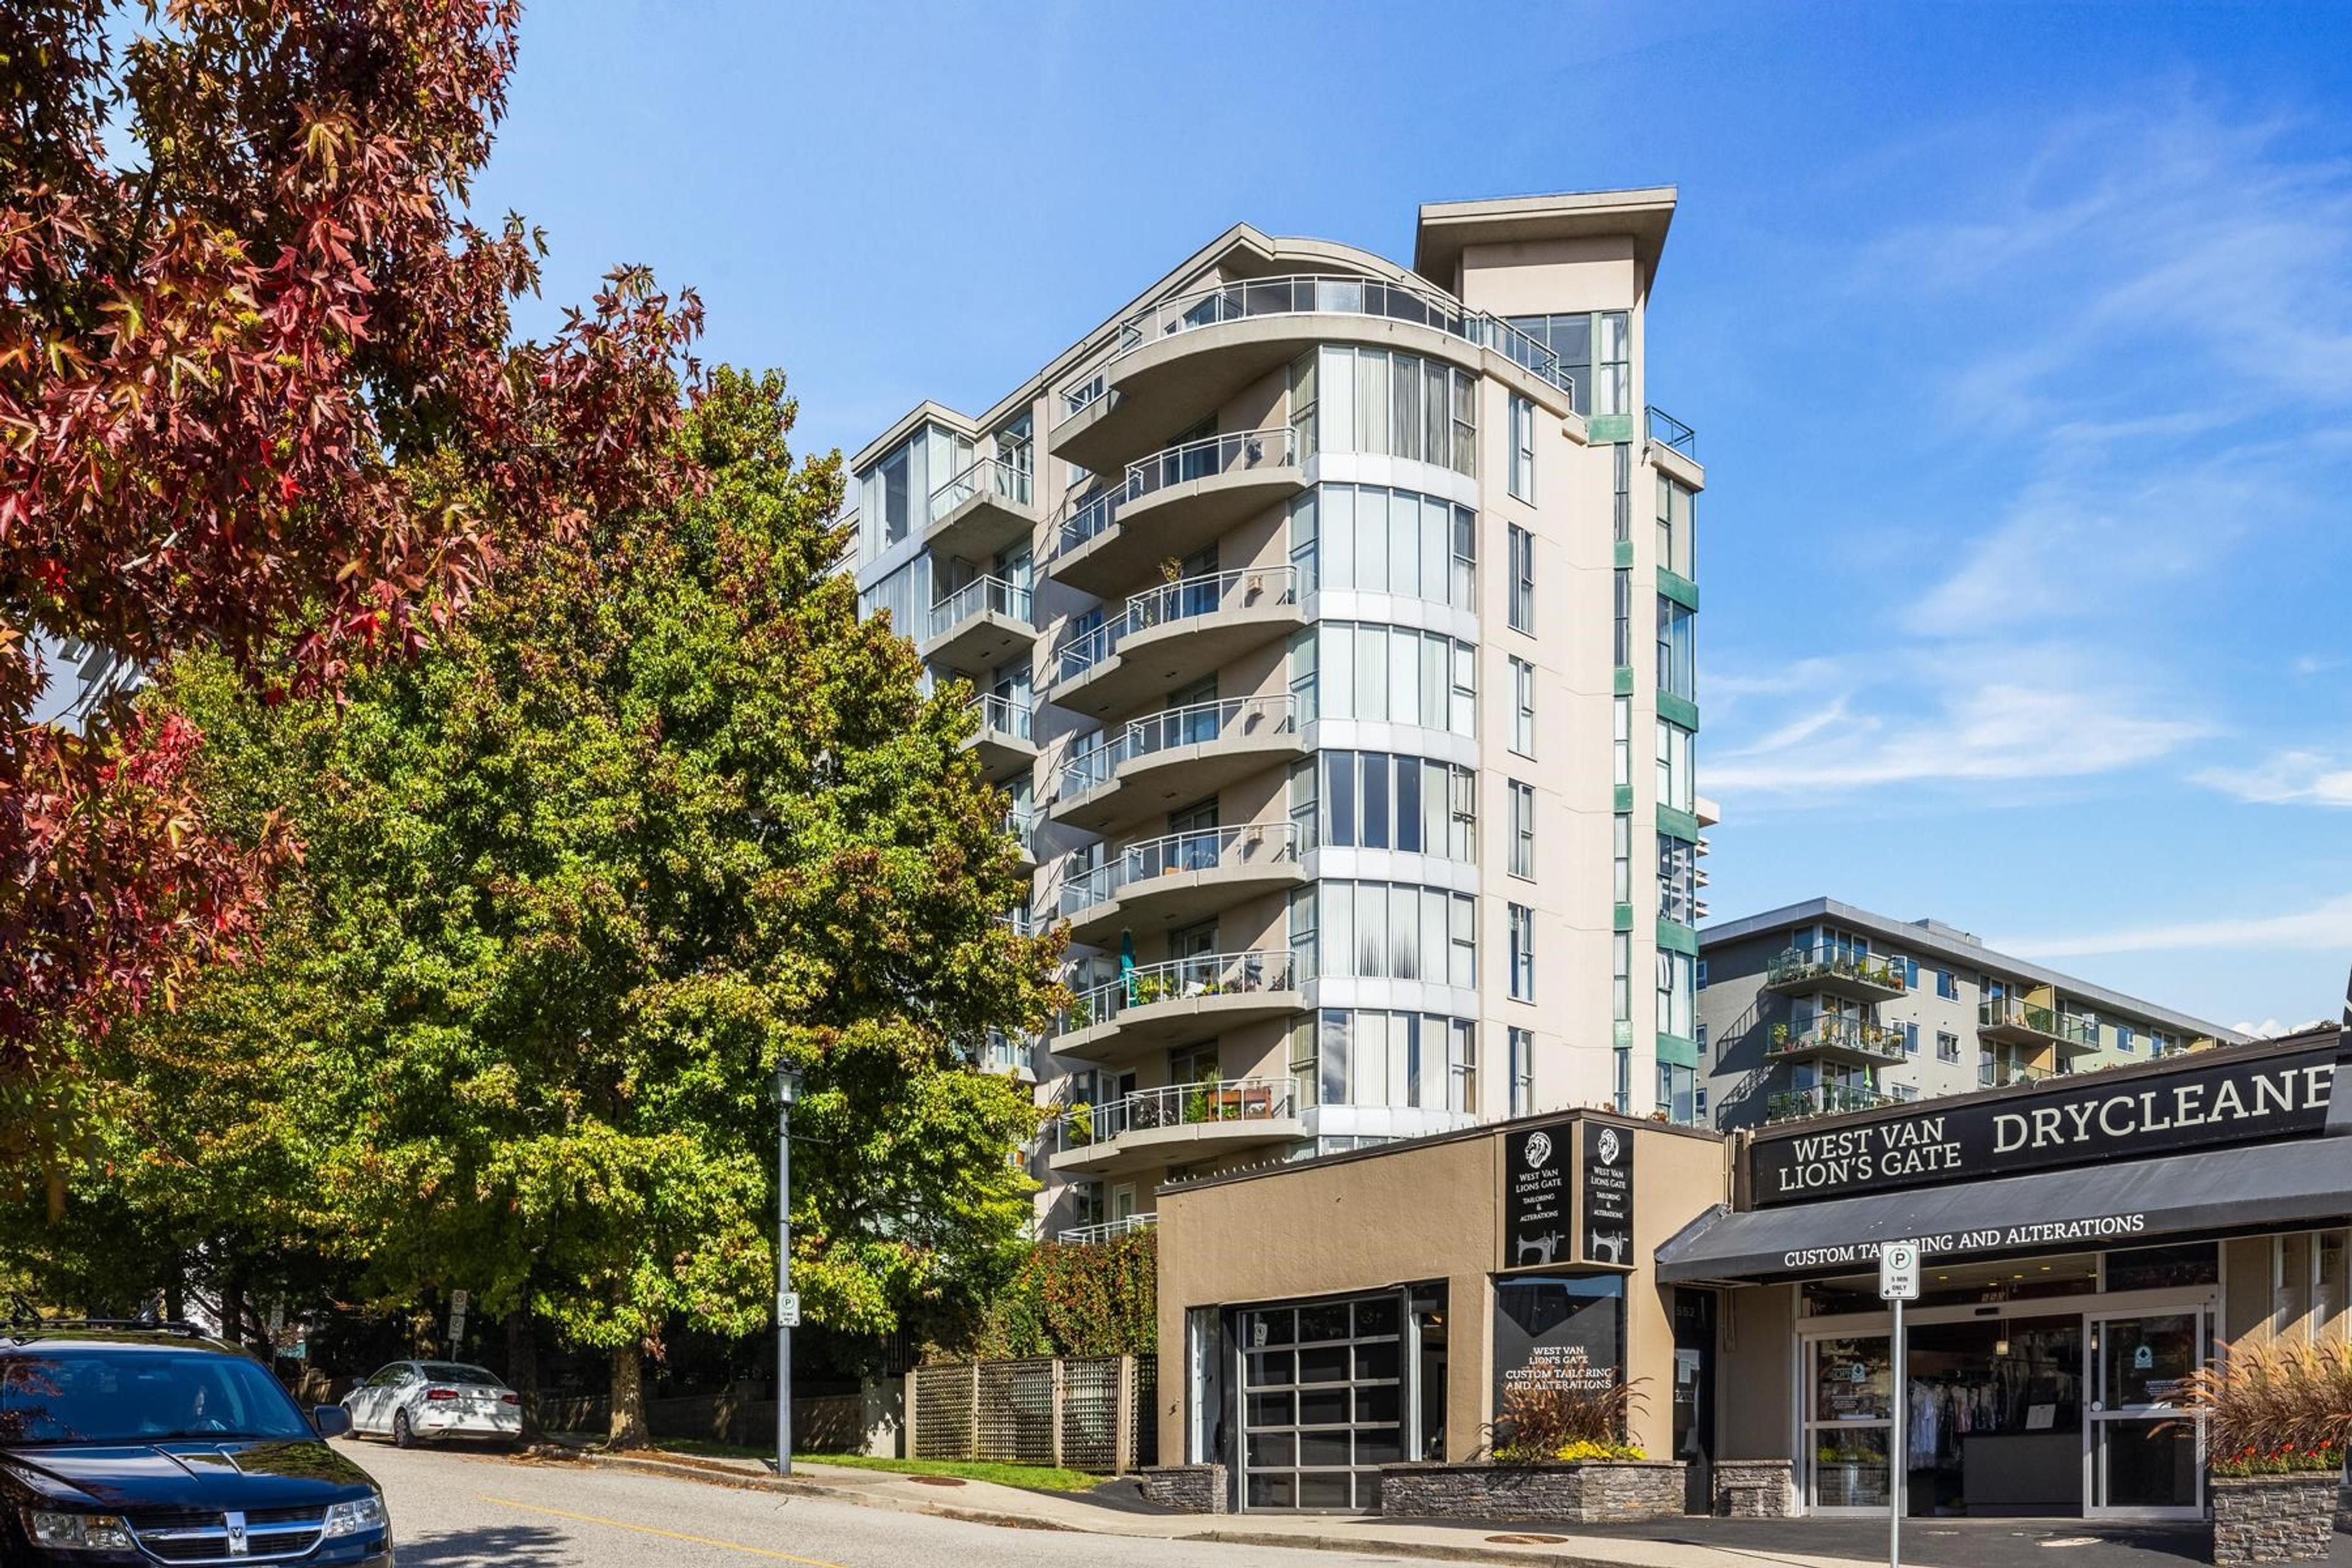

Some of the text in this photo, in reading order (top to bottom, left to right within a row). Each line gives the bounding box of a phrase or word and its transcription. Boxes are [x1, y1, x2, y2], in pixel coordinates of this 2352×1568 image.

[1793, 1117, 1945, 1163] WEST VAN
[1593, 1166, 1624, 1178] WEST VAN
[1779, 1142, 1962, 1191] LION'S GATE
[1520, 1168, 1559, 1182] WEST VAN
[1515, 1178, 1562, 1193] LIONS GATE
[1591, 1175, 1626, 1189] LIONS GATE
[1523, 1193, 1556, 1205] TAILORING
[1596, 1191, 1621, 1201] TAILORING
[1519, 1209, 1559, 1223] ALTERATIONS
[1593, 1209, 1624, 1219] ALTERATIONS
[1785, 1245, 1855, 1267] CUSTOM
[1958, 1230, 2000, 1249] AND
[2006, 1214, 2144, 1244] ALTERATIONS
[1896, 1253, 1905, 1265] P
[1562, 1346, 1584, 1355] VAN
[1529, 1355, 1588, 1365] LION'S GATE
[1506, 1370, 1552, 1379] CUSTOM
[1506, 1379, 1612, 1390] AND ALTERATIONS
